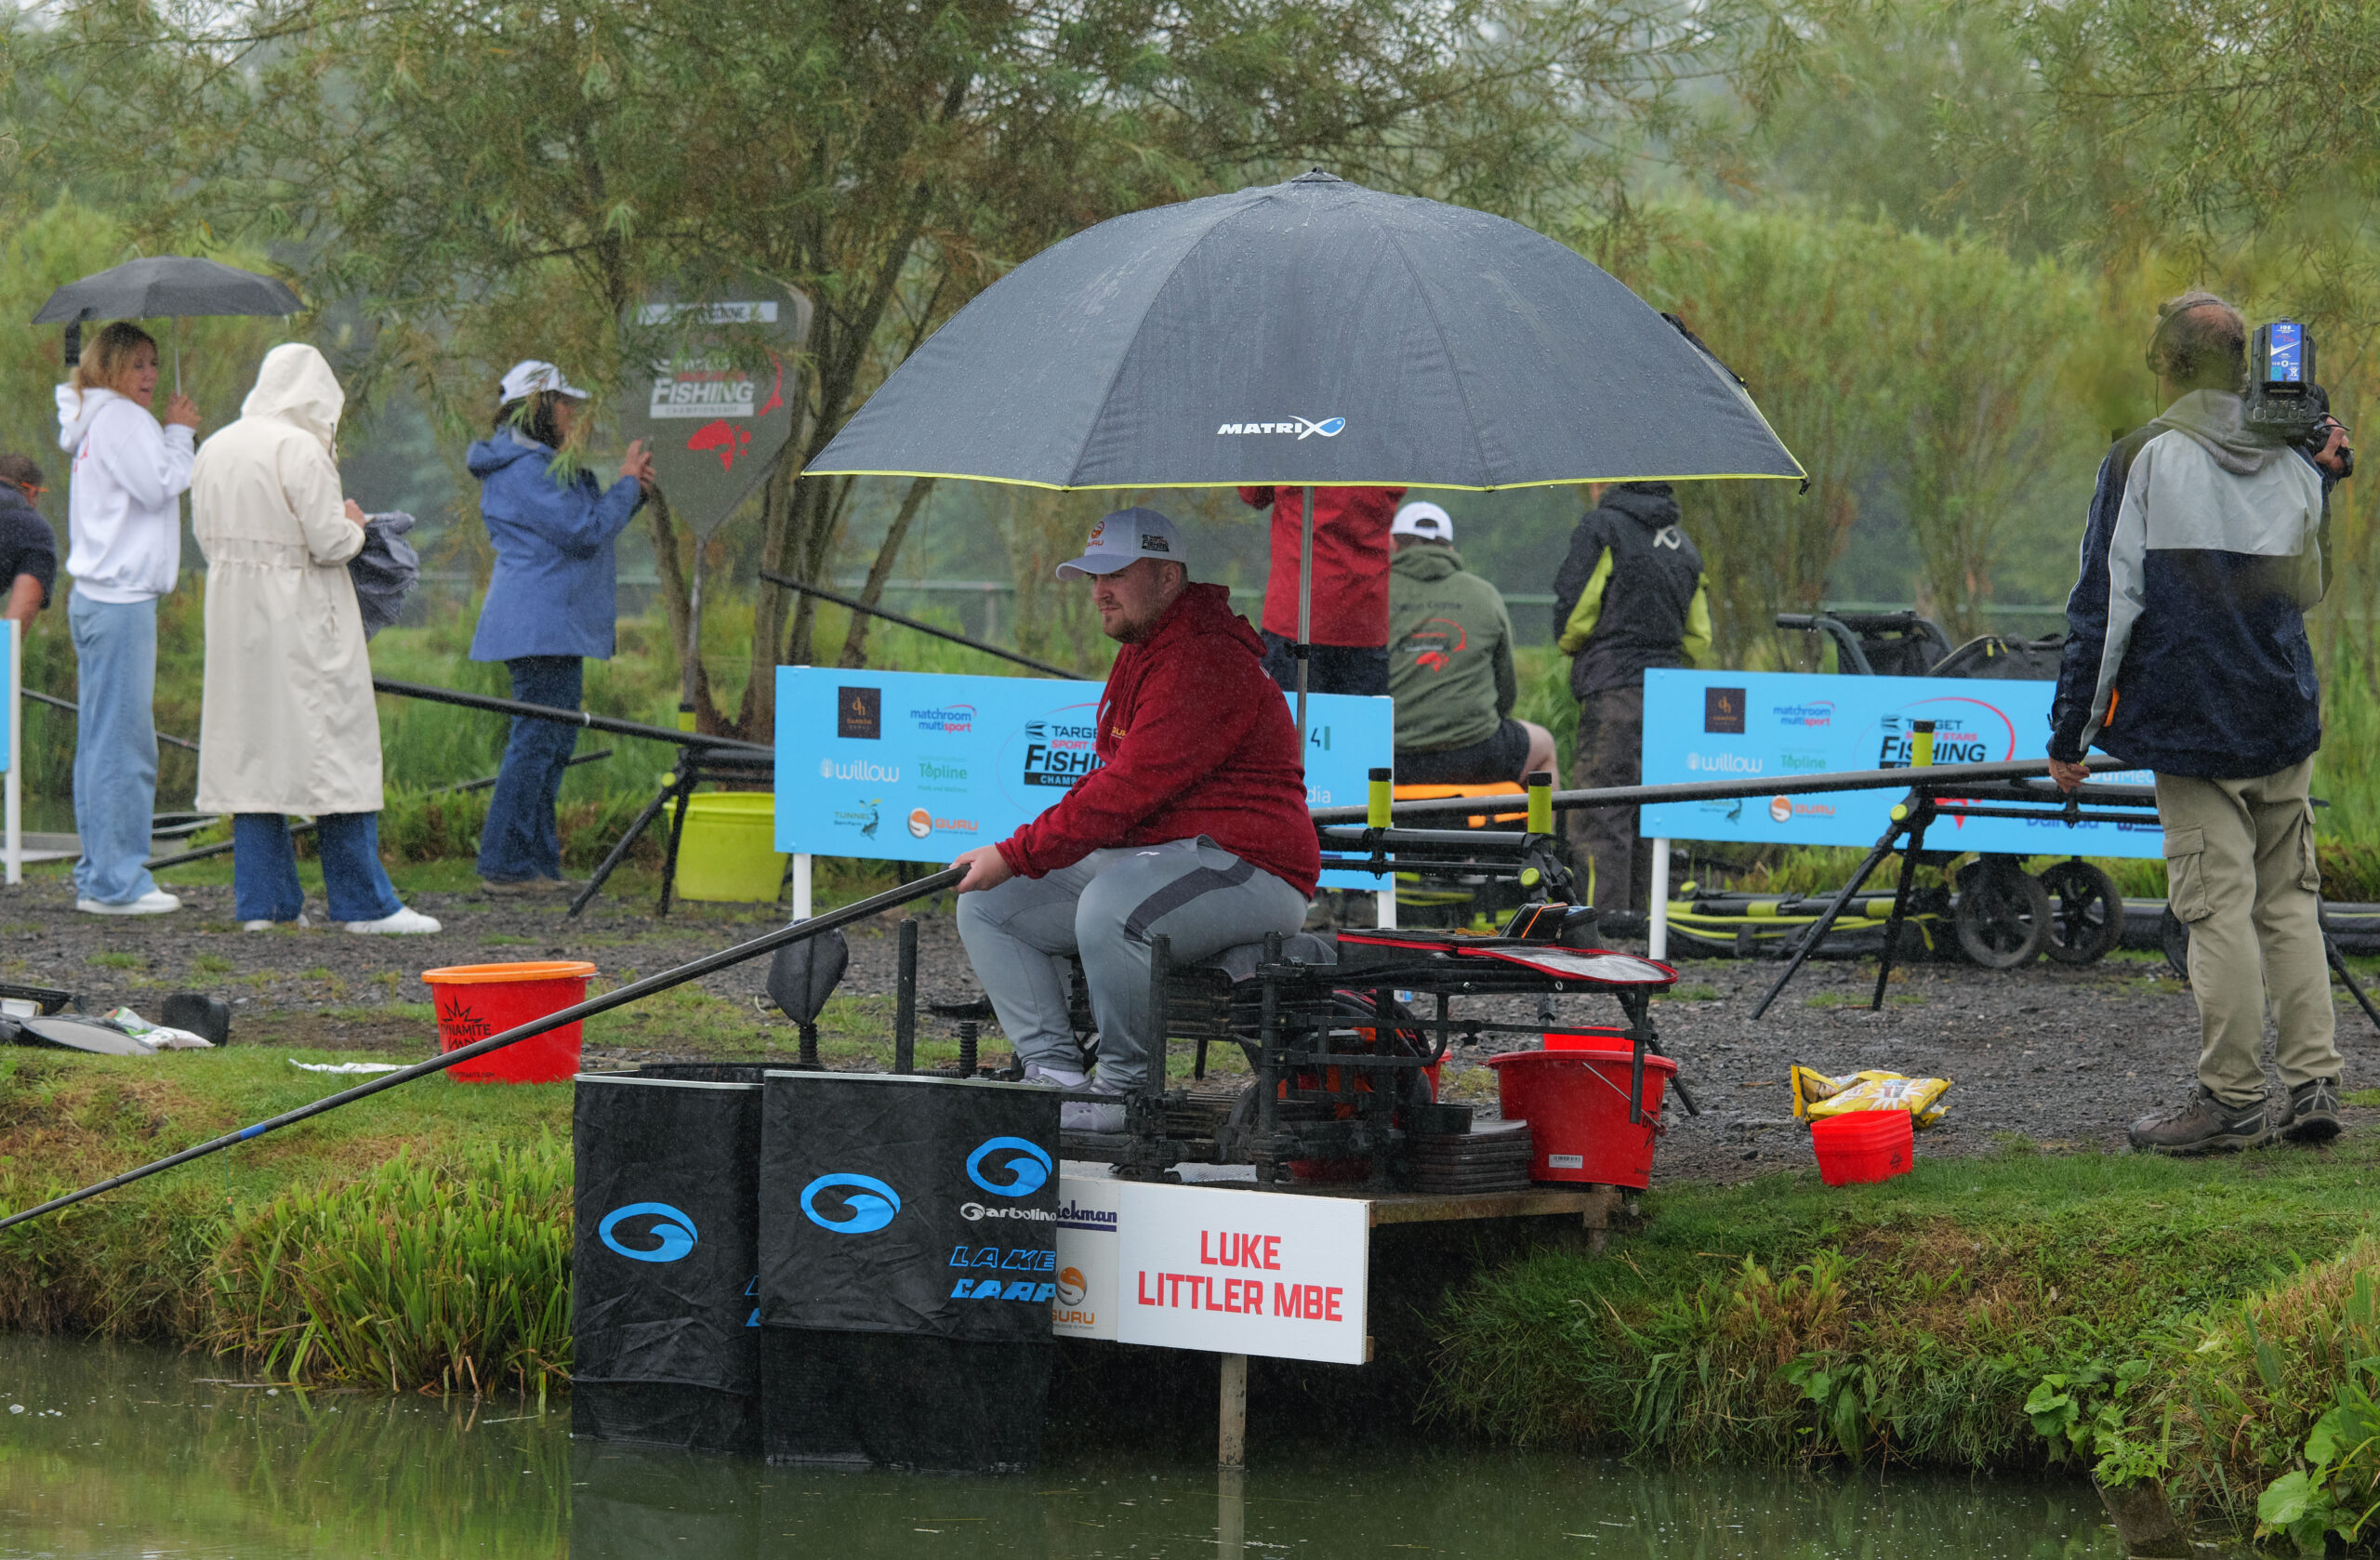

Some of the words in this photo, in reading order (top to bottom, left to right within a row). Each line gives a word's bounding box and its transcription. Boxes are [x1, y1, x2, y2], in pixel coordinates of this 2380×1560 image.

[653, 377, 754, 403] FISHING
[1217, 416, 1345, 440] MATRIX
[910, 707, 972, 721] matchroom
[1773, 705, 1831, 716] matchroom
[919, 720, 972, 734] multisport
[1780, 717, 1831, 728] multisport
[1905, 719, 1964, 731] TGET
[1051, 725, 1098, 739] TARGE
[1942, 733, 1977, 742] STARS
[1051, 739, 1089, 750] SPORT
[836, 760, 899, 783] willow
[1702, 754, 1763, 773] willow
[934, 818, 978, 831] GURU
[960, 1202, 1058, 1222] Garbolino
[1200, 1230, 1281, 1270] LUKE
[949, 1246, 1057, 1271] LAKE
[950, 1278, 1057, 1302] CARP
[1138, 1271, 1263, 1315] LITTLER
[1274, 1282, 1343, 1322] MBE
